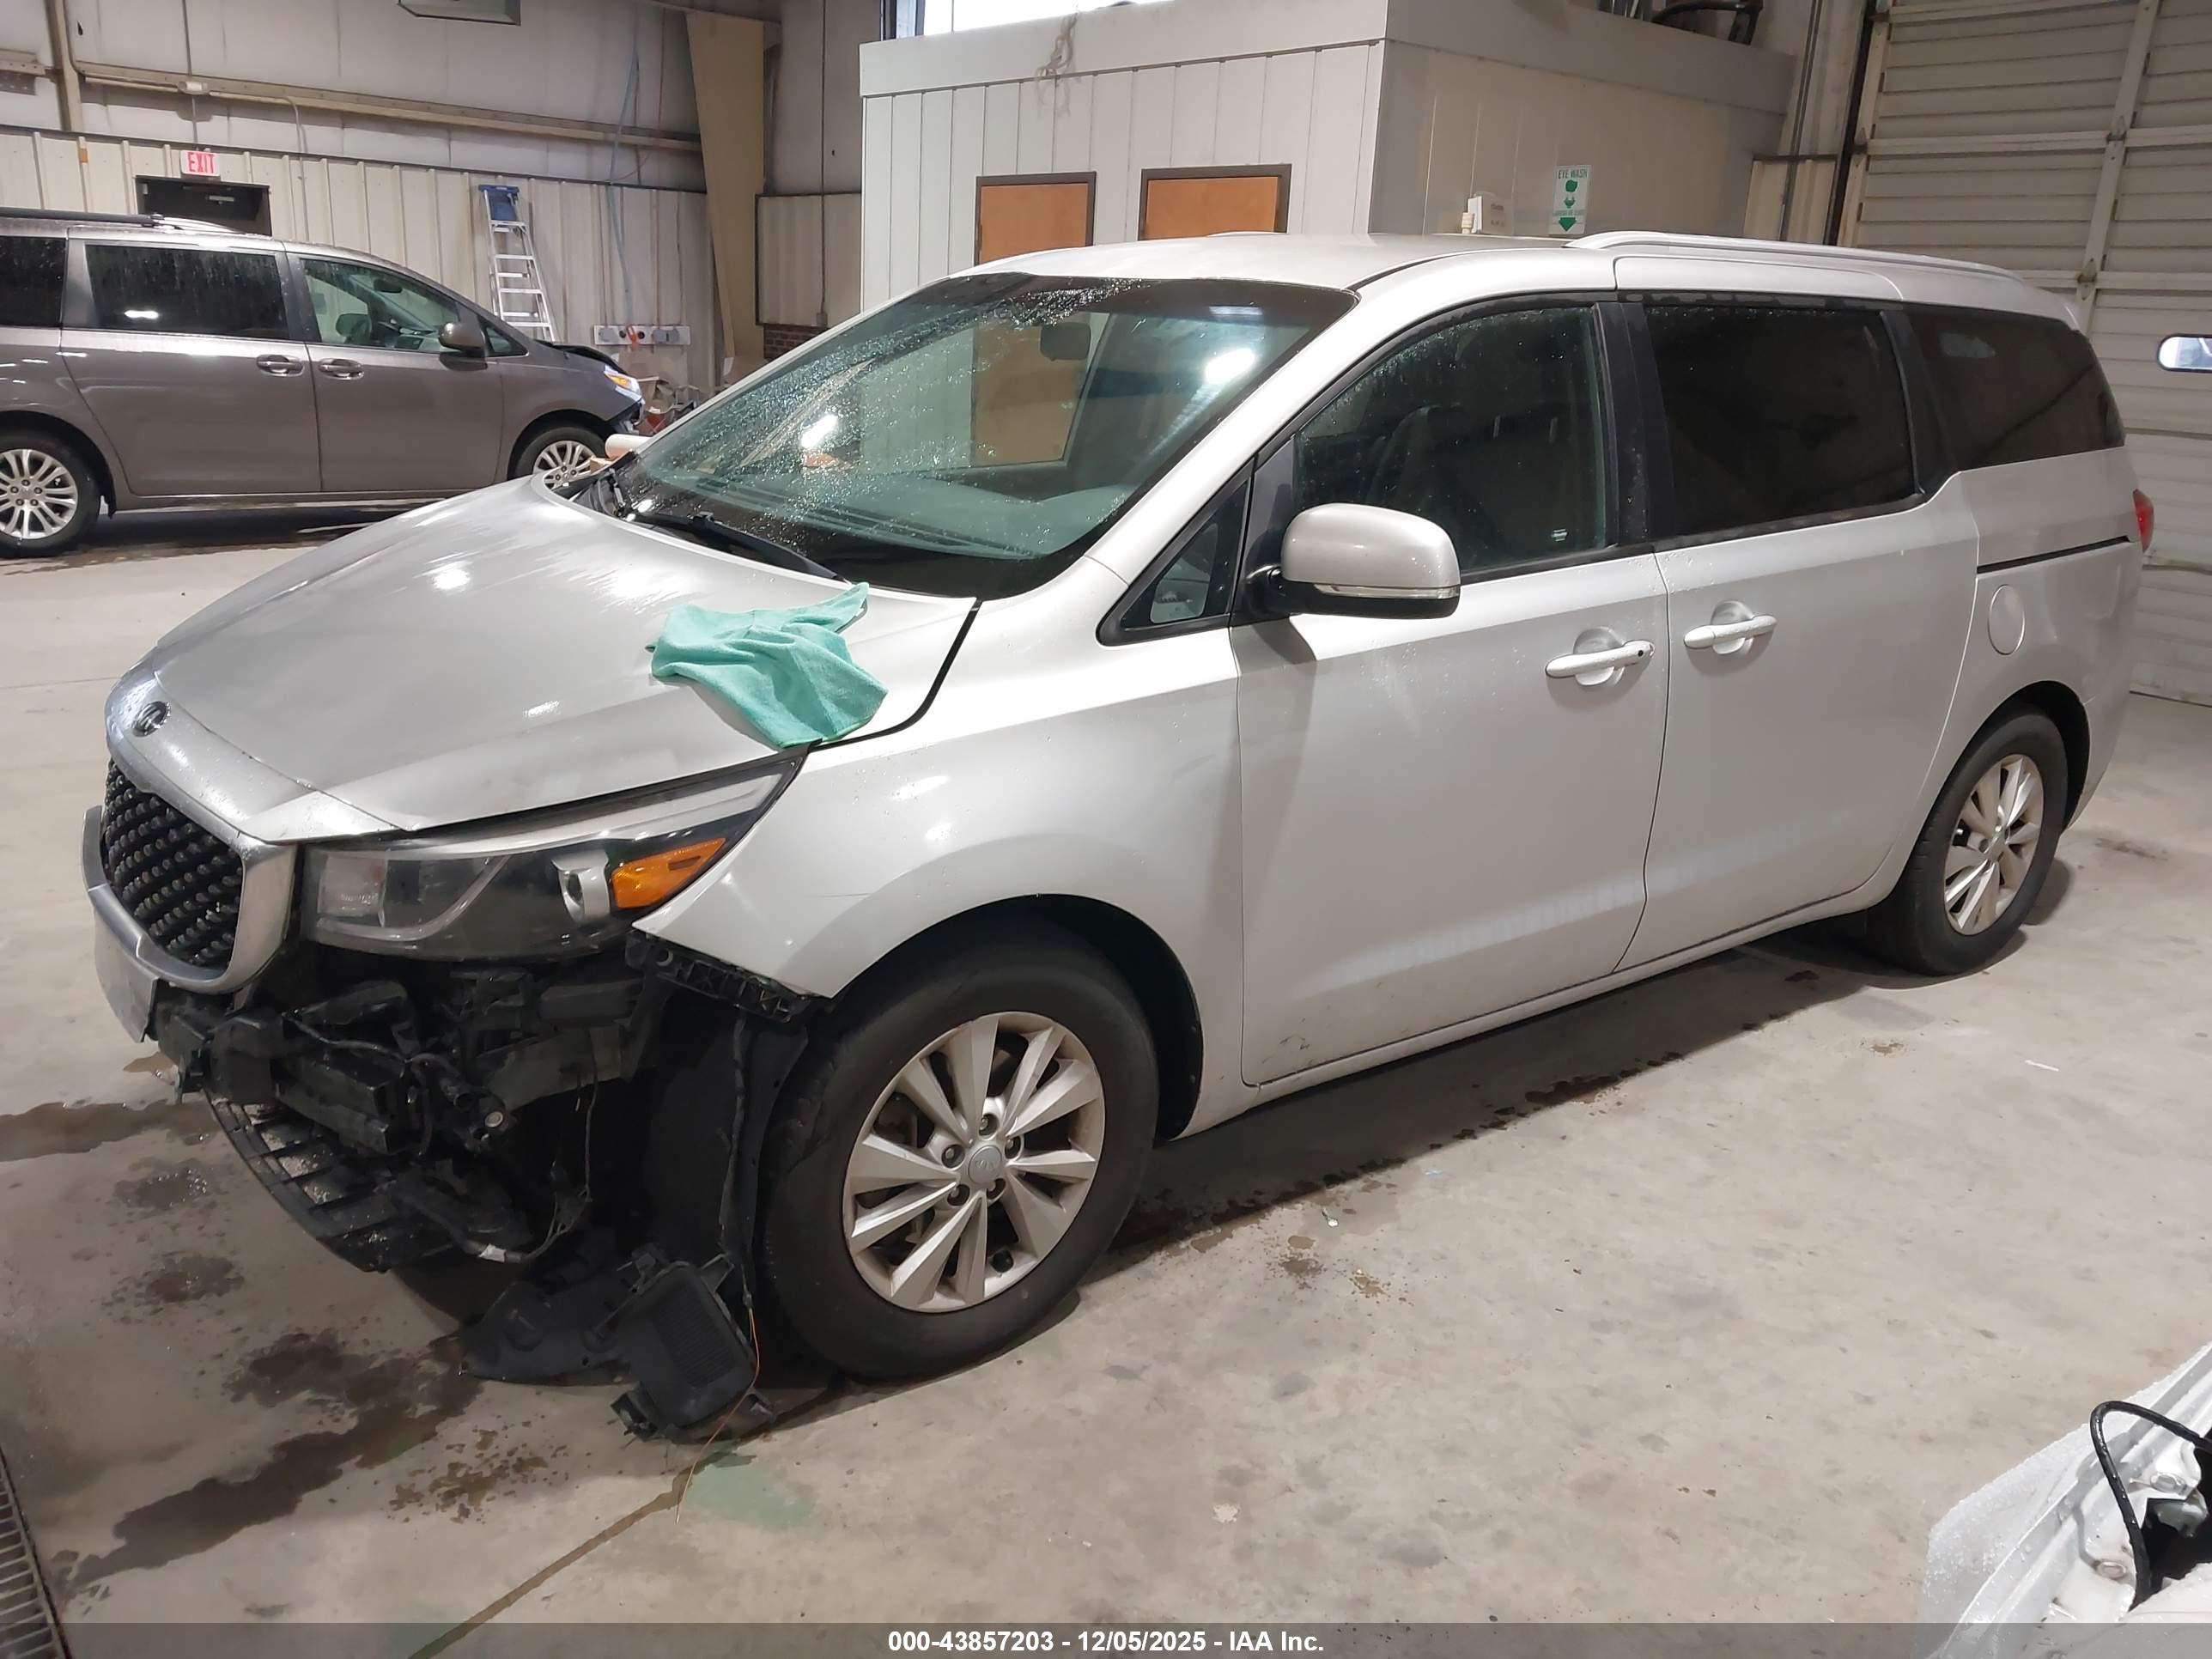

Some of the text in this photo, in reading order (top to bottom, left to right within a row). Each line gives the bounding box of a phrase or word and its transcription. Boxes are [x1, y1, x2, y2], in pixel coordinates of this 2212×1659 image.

[187, 152, 214, 173] EXIT
[1558, 169, 1588, 179] EYE WASH
